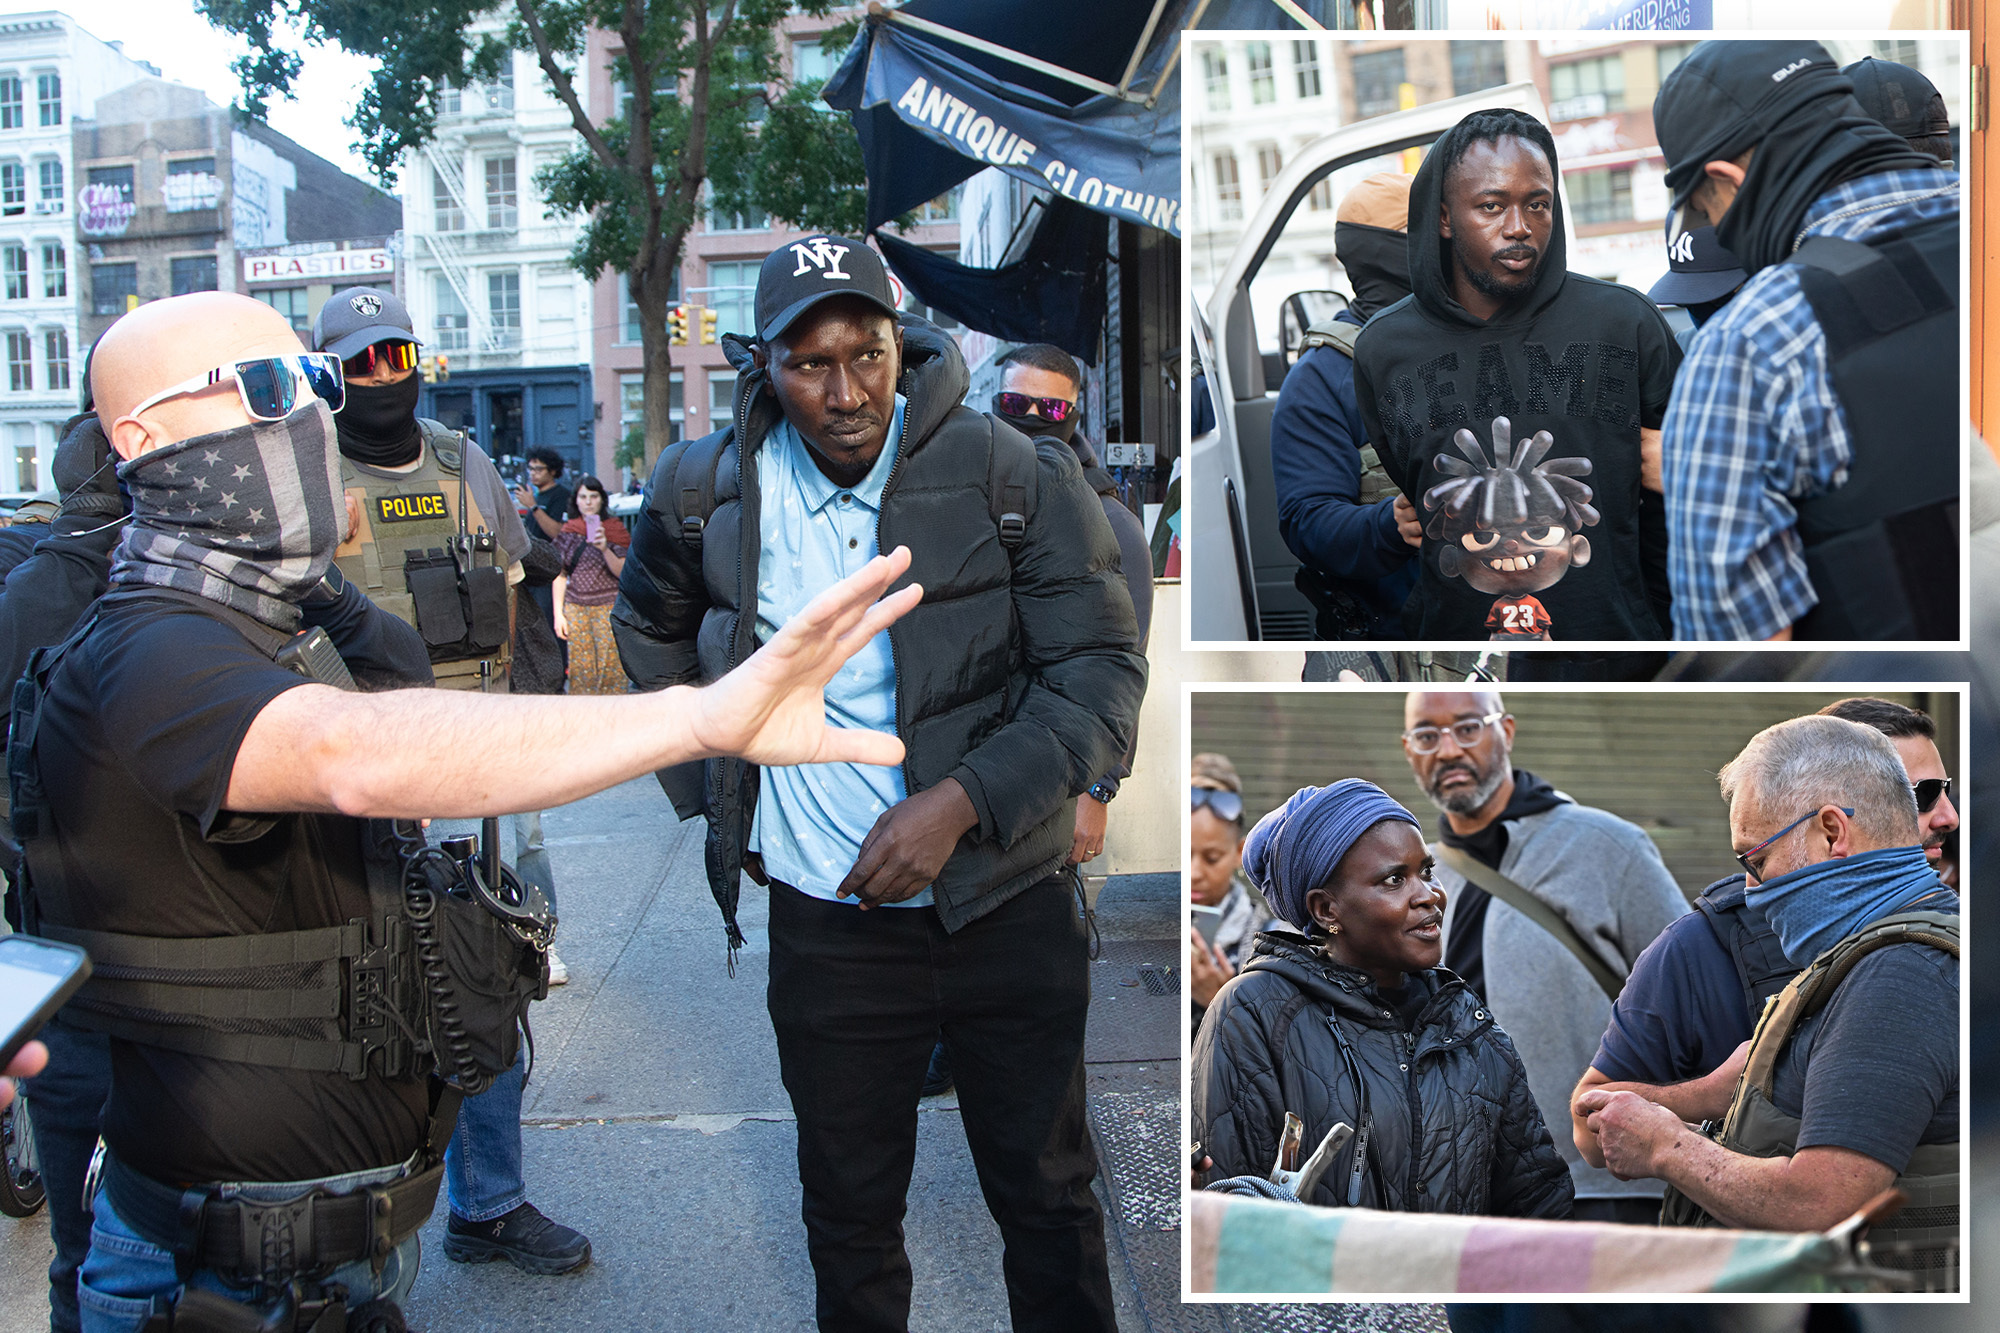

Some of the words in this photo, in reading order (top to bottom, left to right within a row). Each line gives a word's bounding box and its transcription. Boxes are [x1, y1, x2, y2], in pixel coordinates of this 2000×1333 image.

[898, 76, 1037, 165] ANTIQUE
[253, 253, 386, 277] PLASTICS
[789, 237, 851, 280] NY
[351, 294, 381, 308] NETS
[381, 495, 446, 518] POLICE
[1502, 604, 1534, 628] 23
